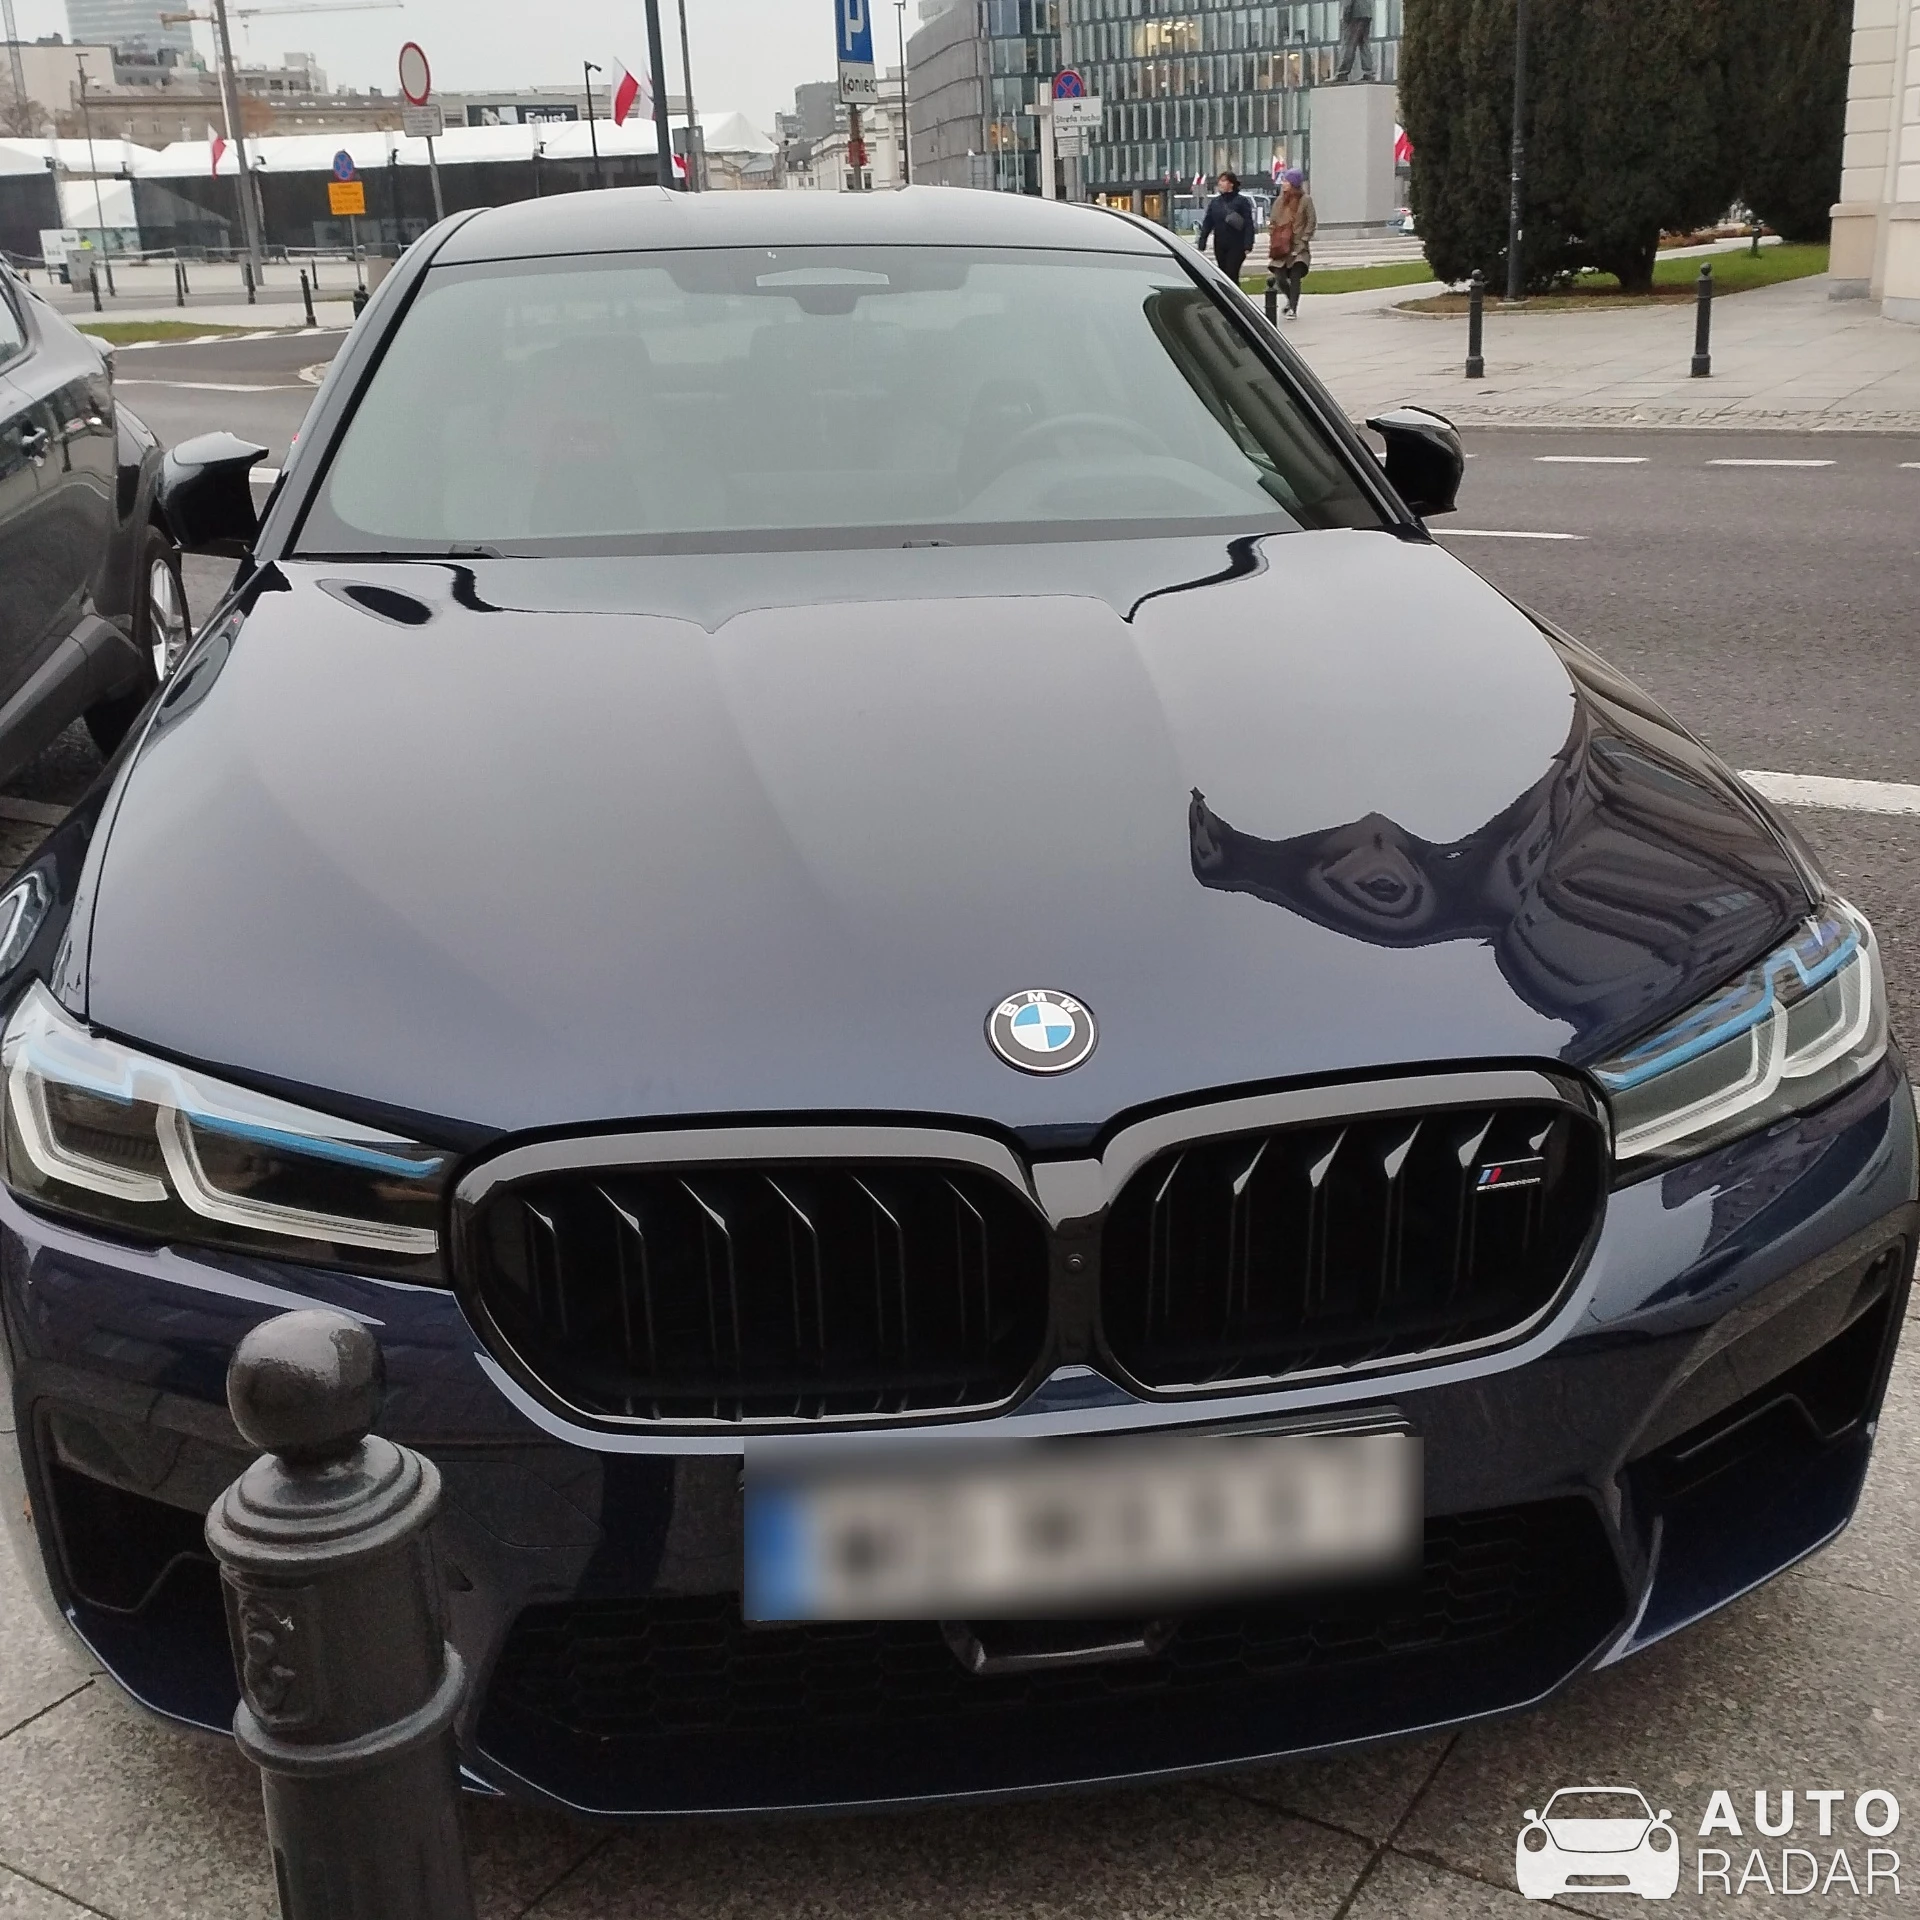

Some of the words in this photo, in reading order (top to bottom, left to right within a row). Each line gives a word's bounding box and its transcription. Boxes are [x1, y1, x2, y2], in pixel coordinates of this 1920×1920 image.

[844, 0, 865, 51] P
[842, 73, 875, 93] Koniec
[525, 112, 568, 124] Faust
[1000, 992, 1080, 1016] BMW
